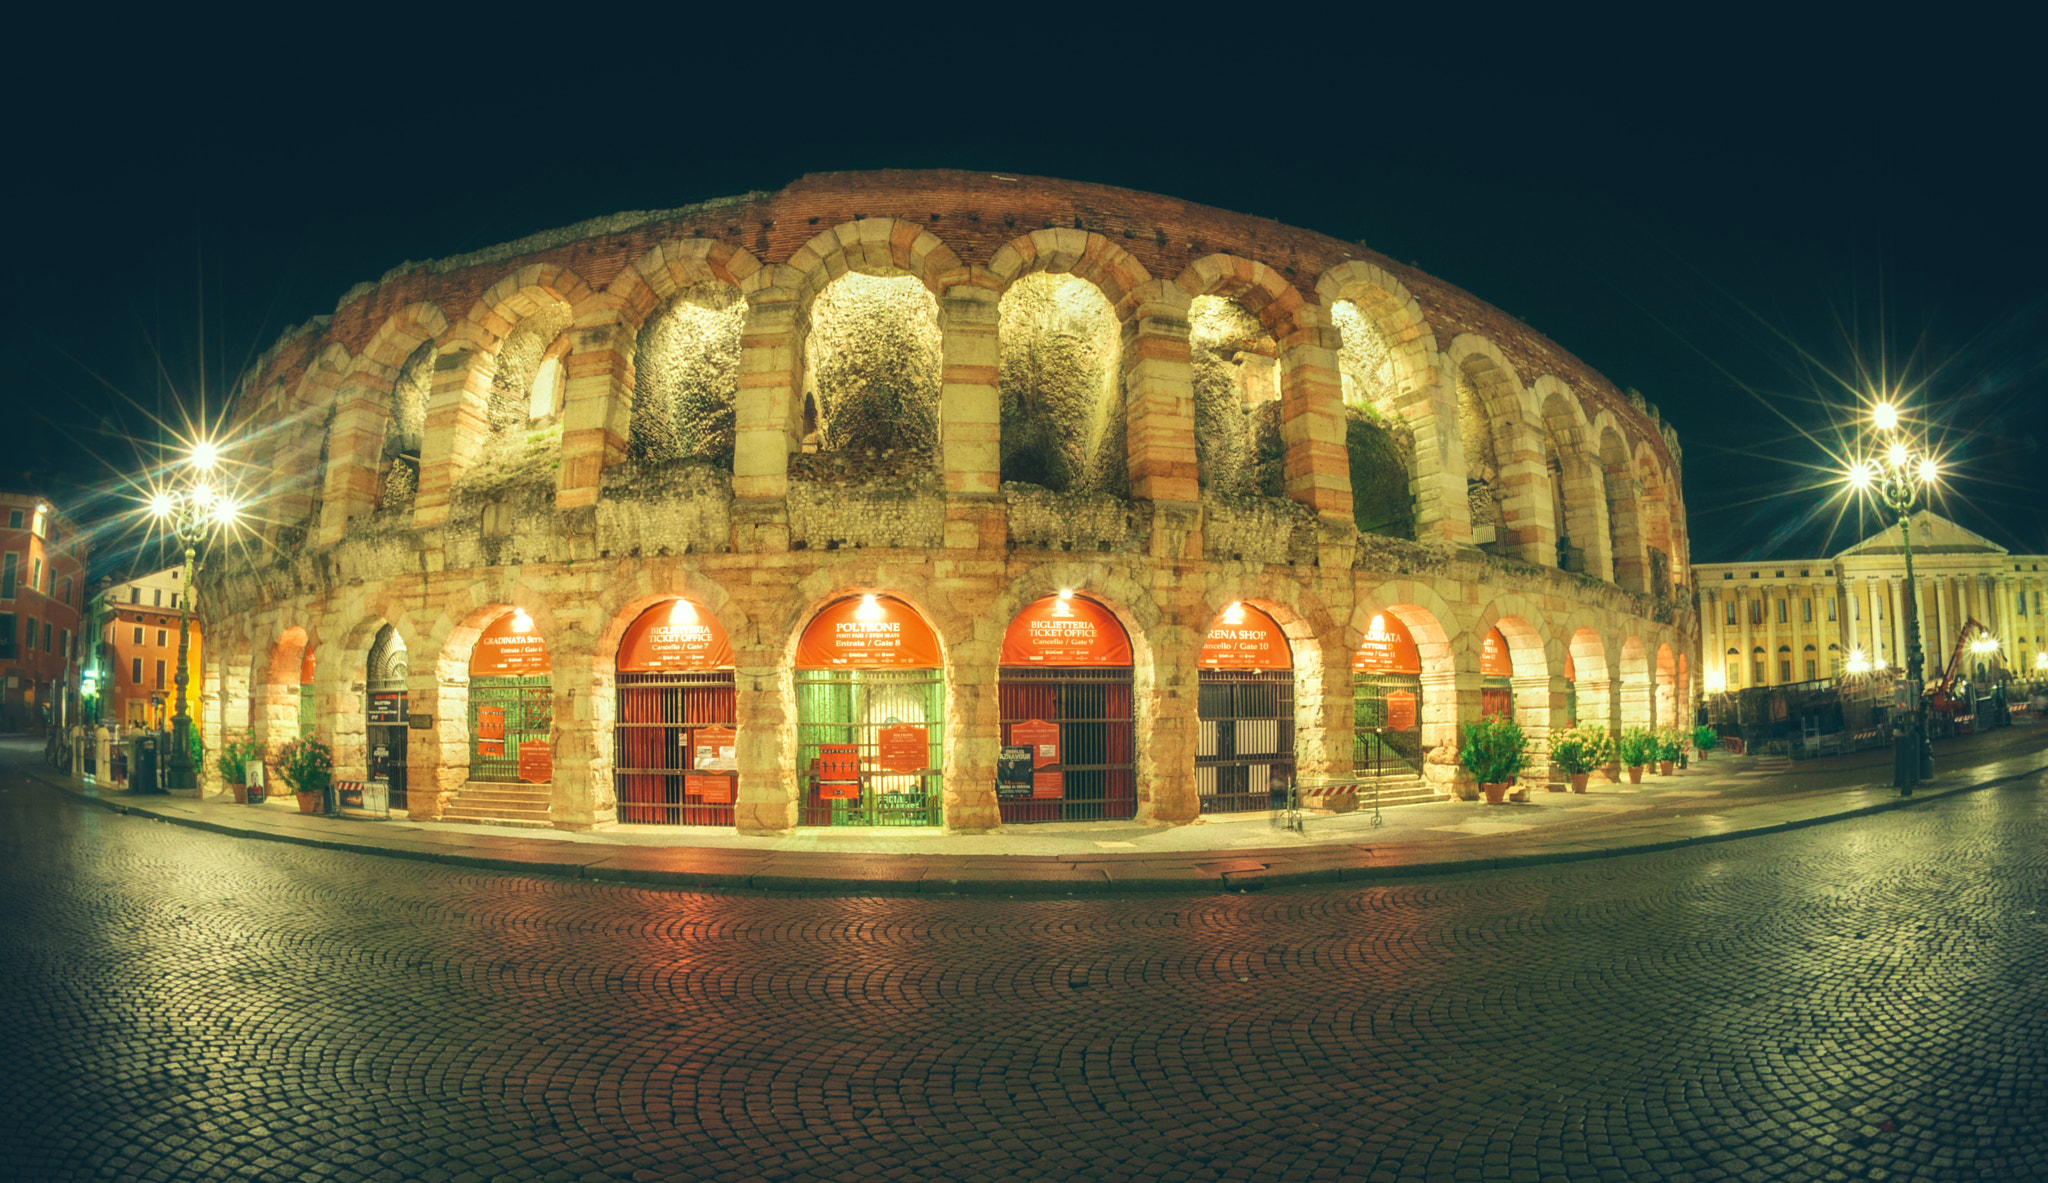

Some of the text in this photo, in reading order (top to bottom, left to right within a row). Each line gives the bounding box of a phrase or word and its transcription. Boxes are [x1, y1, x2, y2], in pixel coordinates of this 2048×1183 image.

[650, 625, 710, 634] BIGLIETTERIA
[836, 622, 900, 632] POLTRONE
[1031, 621, 1094, 629] BIGLIETTERIA
[1028, 628, 1097, 637] TICKET OFFICE
[1207, 630, 1266, 640] RENA SHOP
[1364, 631, 1401, 642] DINATA
[484, 636, 526, 645] GRADINATA
[648, 634, 712, 643] TICKET OFFICE
[652, 643, 680, 651] Cancello
[1202, 642, 1231, 650] ancello
